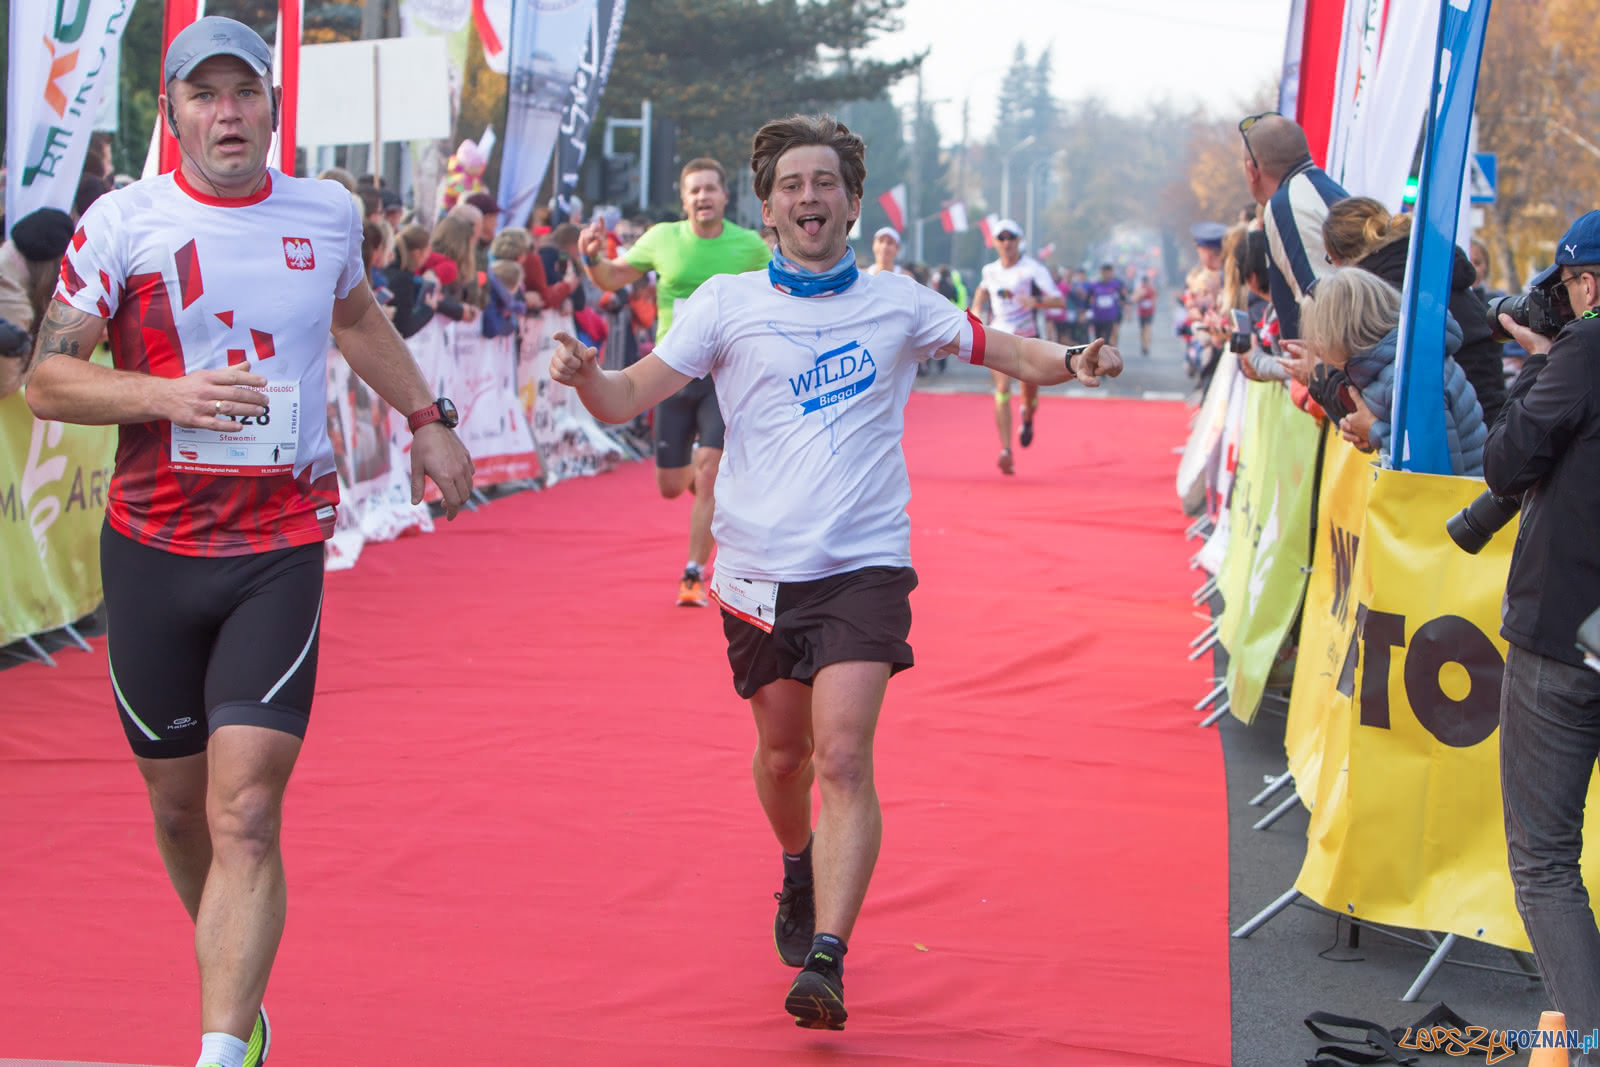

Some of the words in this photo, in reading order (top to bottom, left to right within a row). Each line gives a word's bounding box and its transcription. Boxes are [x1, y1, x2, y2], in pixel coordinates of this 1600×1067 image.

[788, 348, 876, 397] WILDA
[819, 383, 857, 406] Biega!
[219, 434, 257, 442] Sławomir
